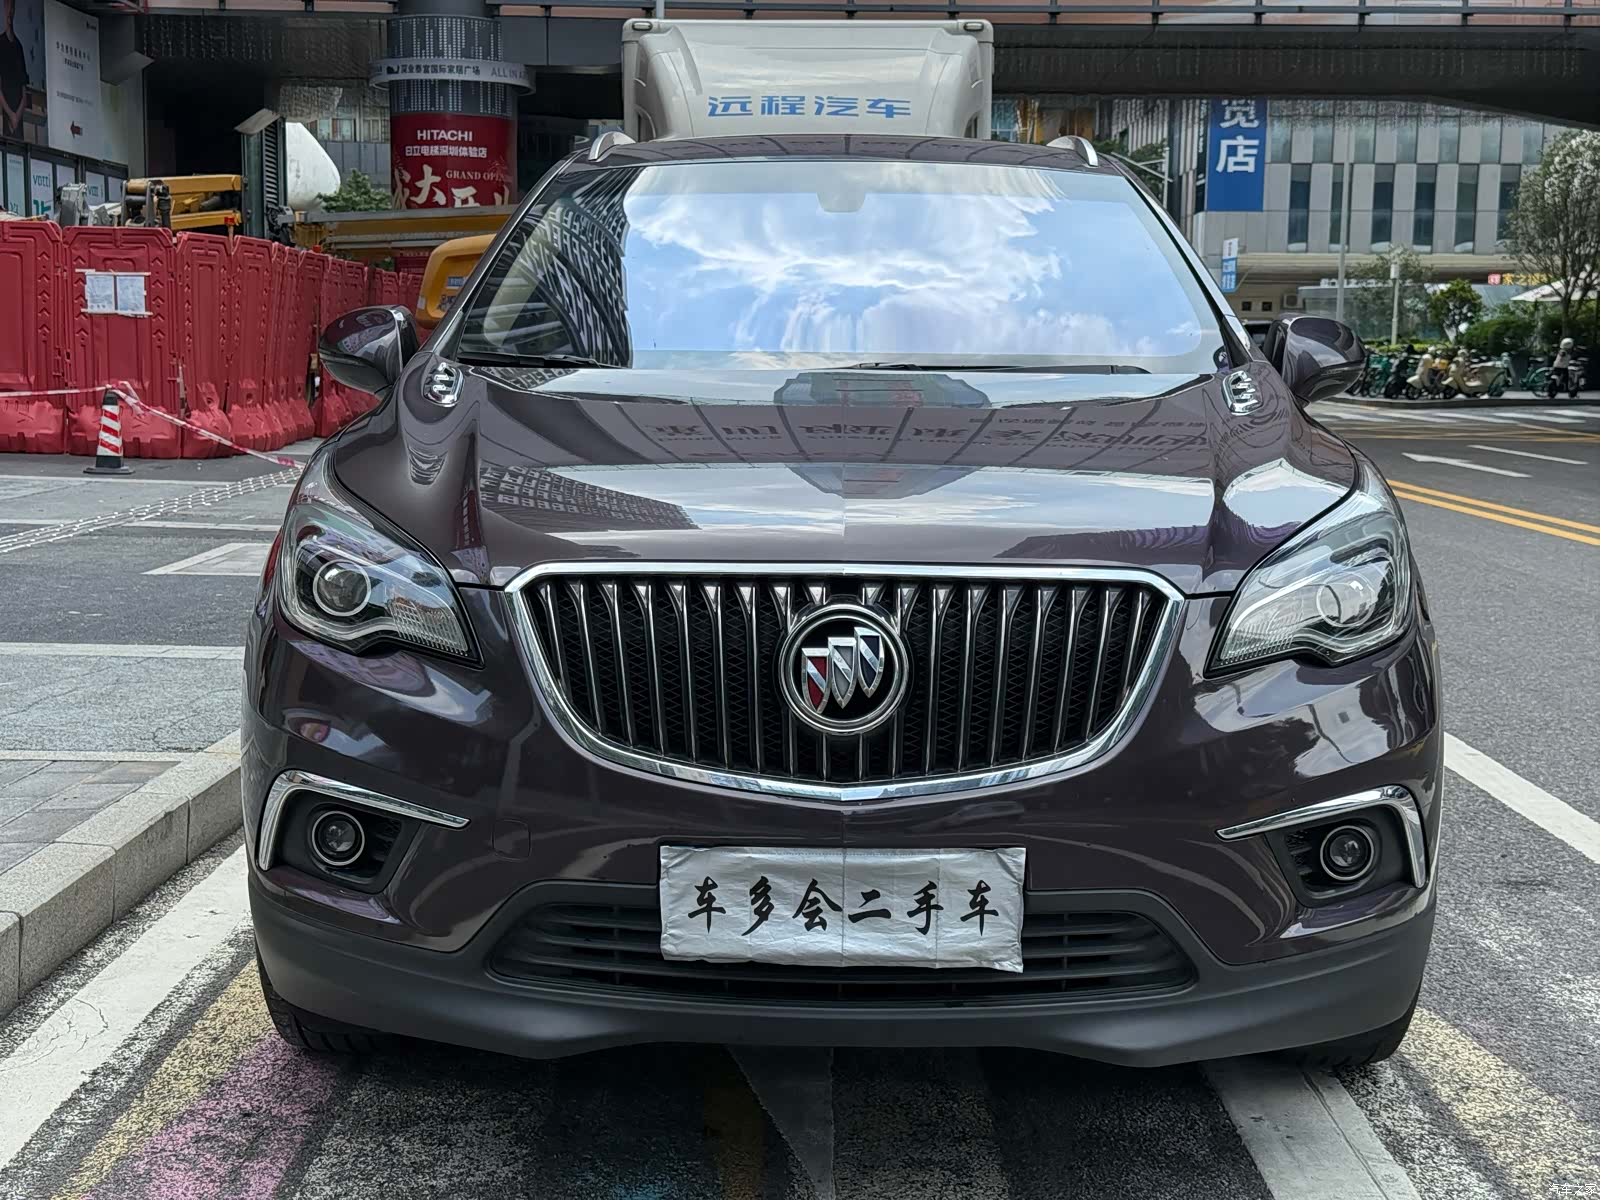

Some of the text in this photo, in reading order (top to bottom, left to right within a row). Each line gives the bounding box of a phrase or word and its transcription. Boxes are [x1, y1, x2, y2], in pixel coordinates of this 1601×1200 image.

[708, 95, 911, 118] 远程汽车
[417, 129, 473, 142] HITACHI
[405, 145, 487, 158] 日立电梯深圳体验店
[445, 169, 480, 180] GRAND
[688, 876, 999, 937] 车多会二手车
